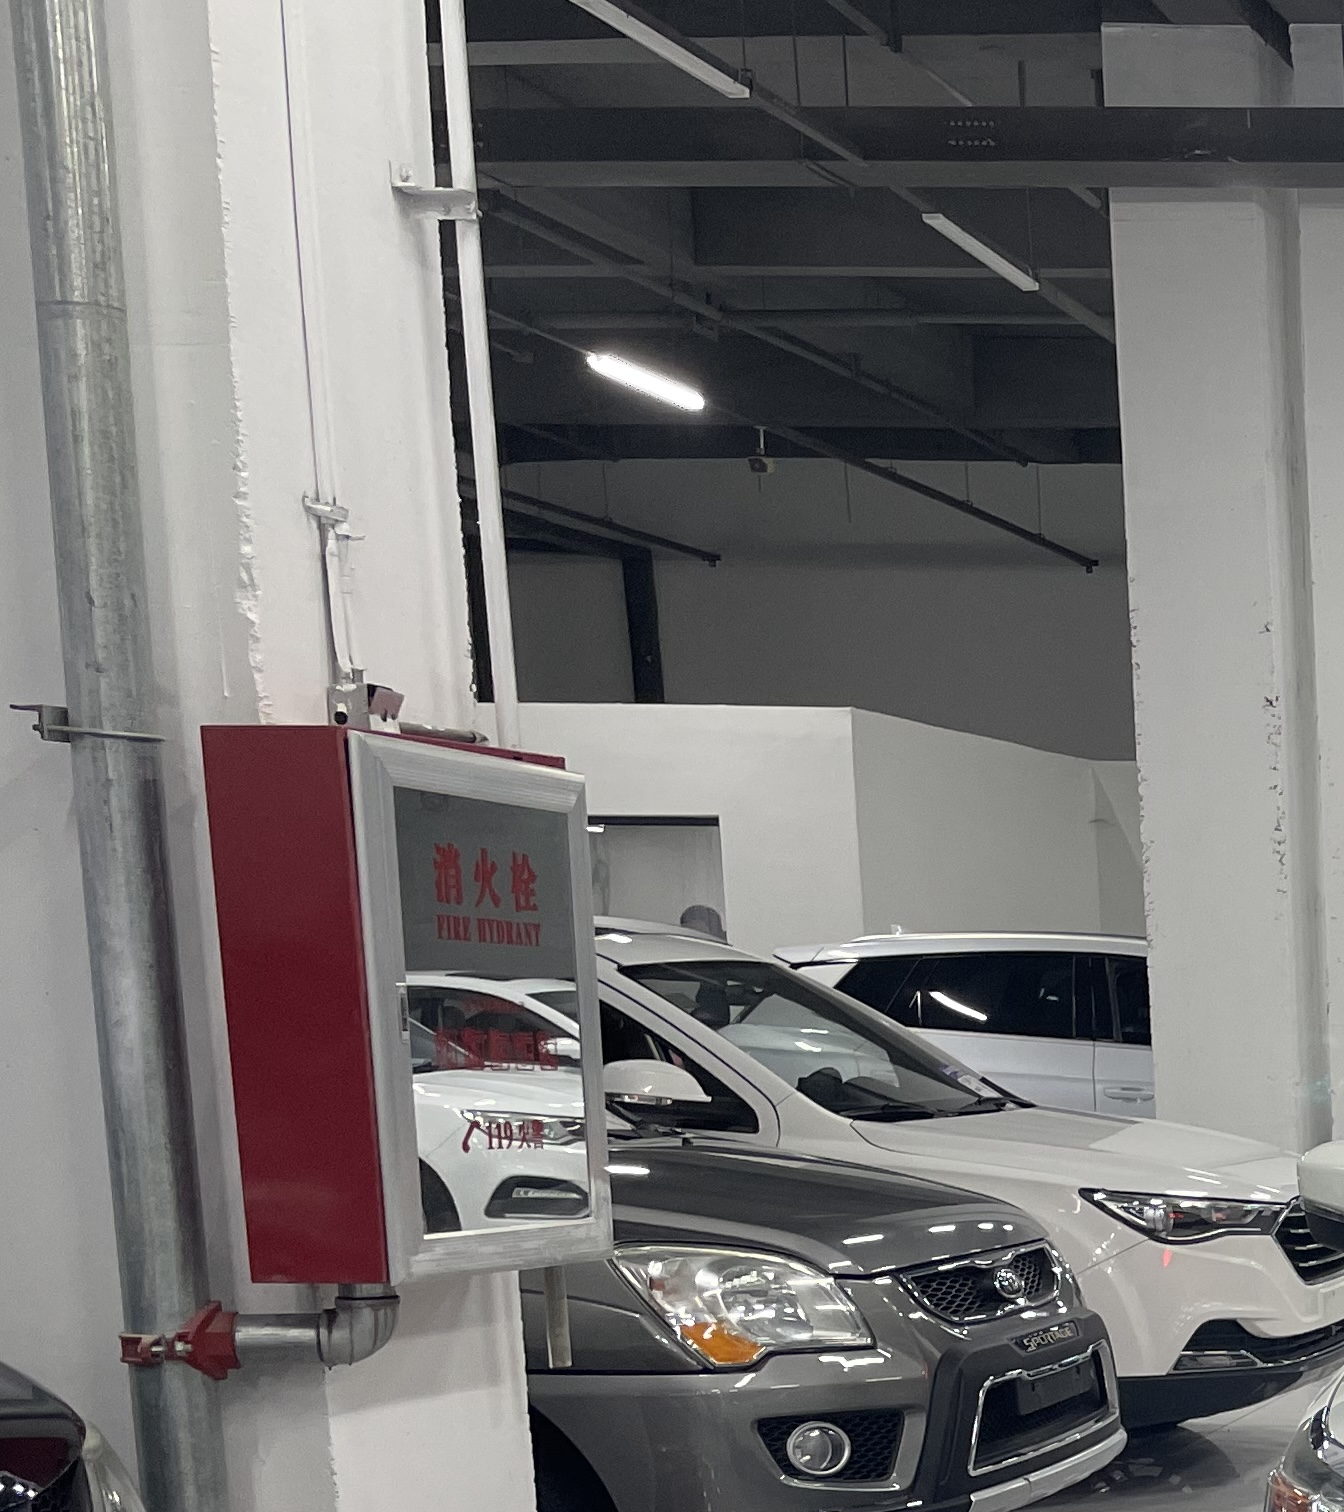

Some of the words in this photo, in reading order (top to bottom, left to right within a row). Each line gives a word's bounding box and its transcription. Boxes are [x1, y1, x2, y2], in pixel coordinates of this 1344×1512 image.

[433, 843, 539, 912] 消火栓
[436, 915, 472, 942] FIRE
[477, 918, 541, 947] HYDRANT
[486, 1121, 513, 1150] 119
[518, 1120, 545, 1150] 火警
[1023, 1327, 1074, 1352] SPORTAGE
